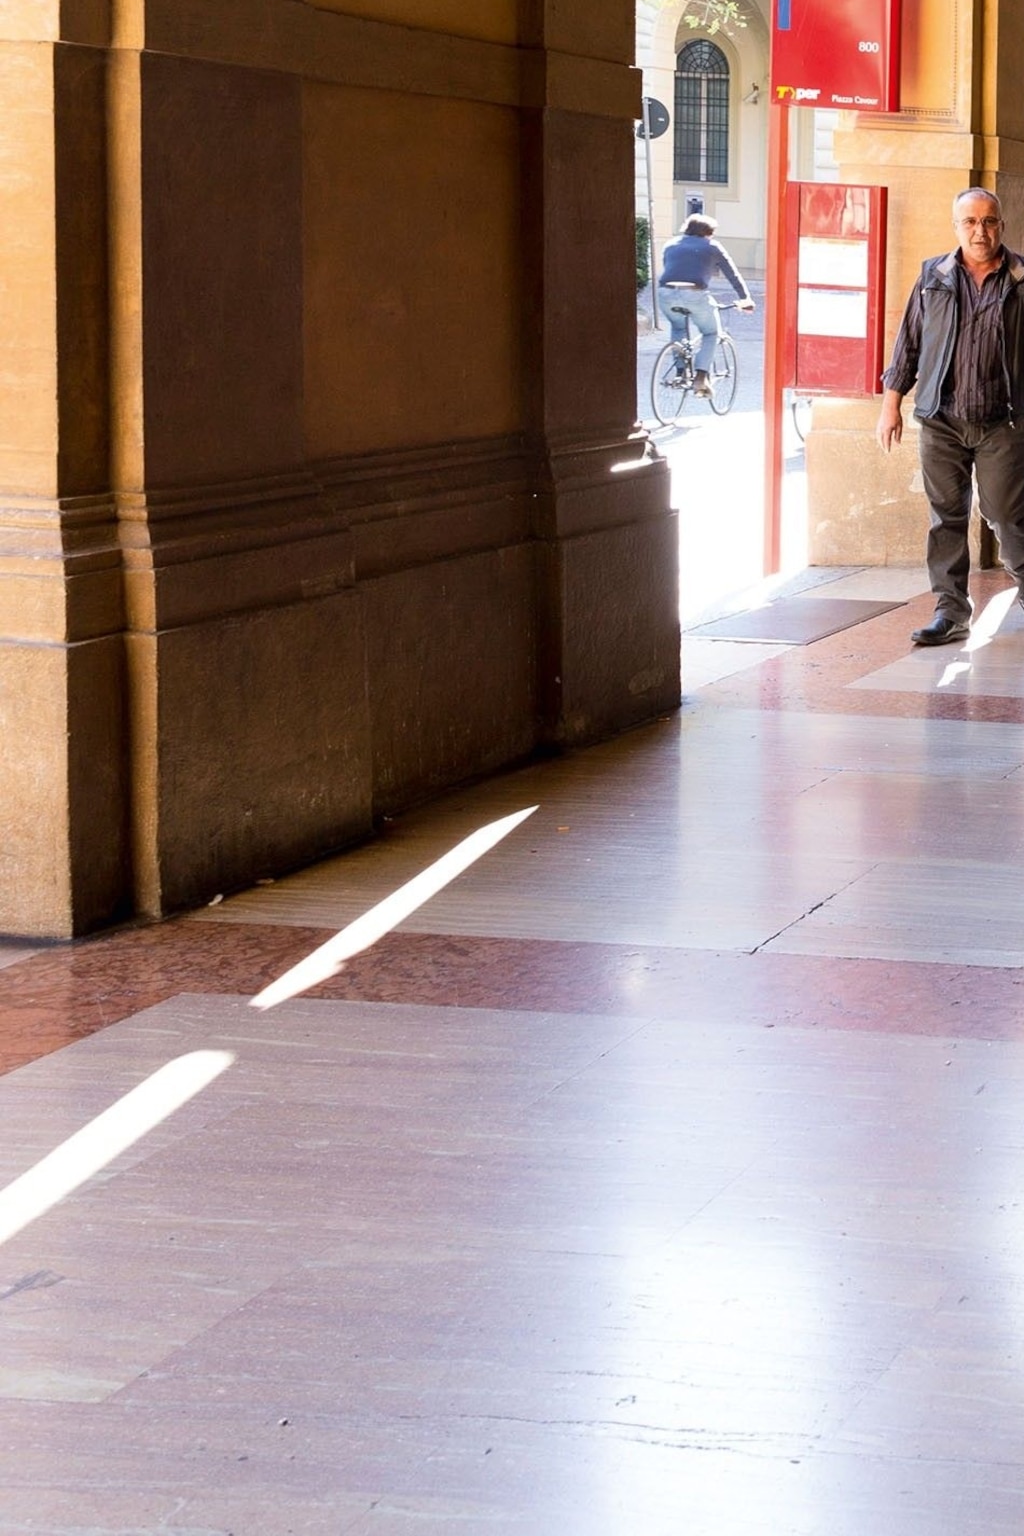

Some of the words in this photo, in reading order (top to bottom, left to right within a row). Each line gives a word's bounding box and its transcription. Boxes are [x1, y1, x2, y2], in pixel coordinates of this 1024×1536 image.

[858, 42, 879, 53] 800
[831, 95, 853, 103] Piazza
[855, 96, 878, 105] Cavour
